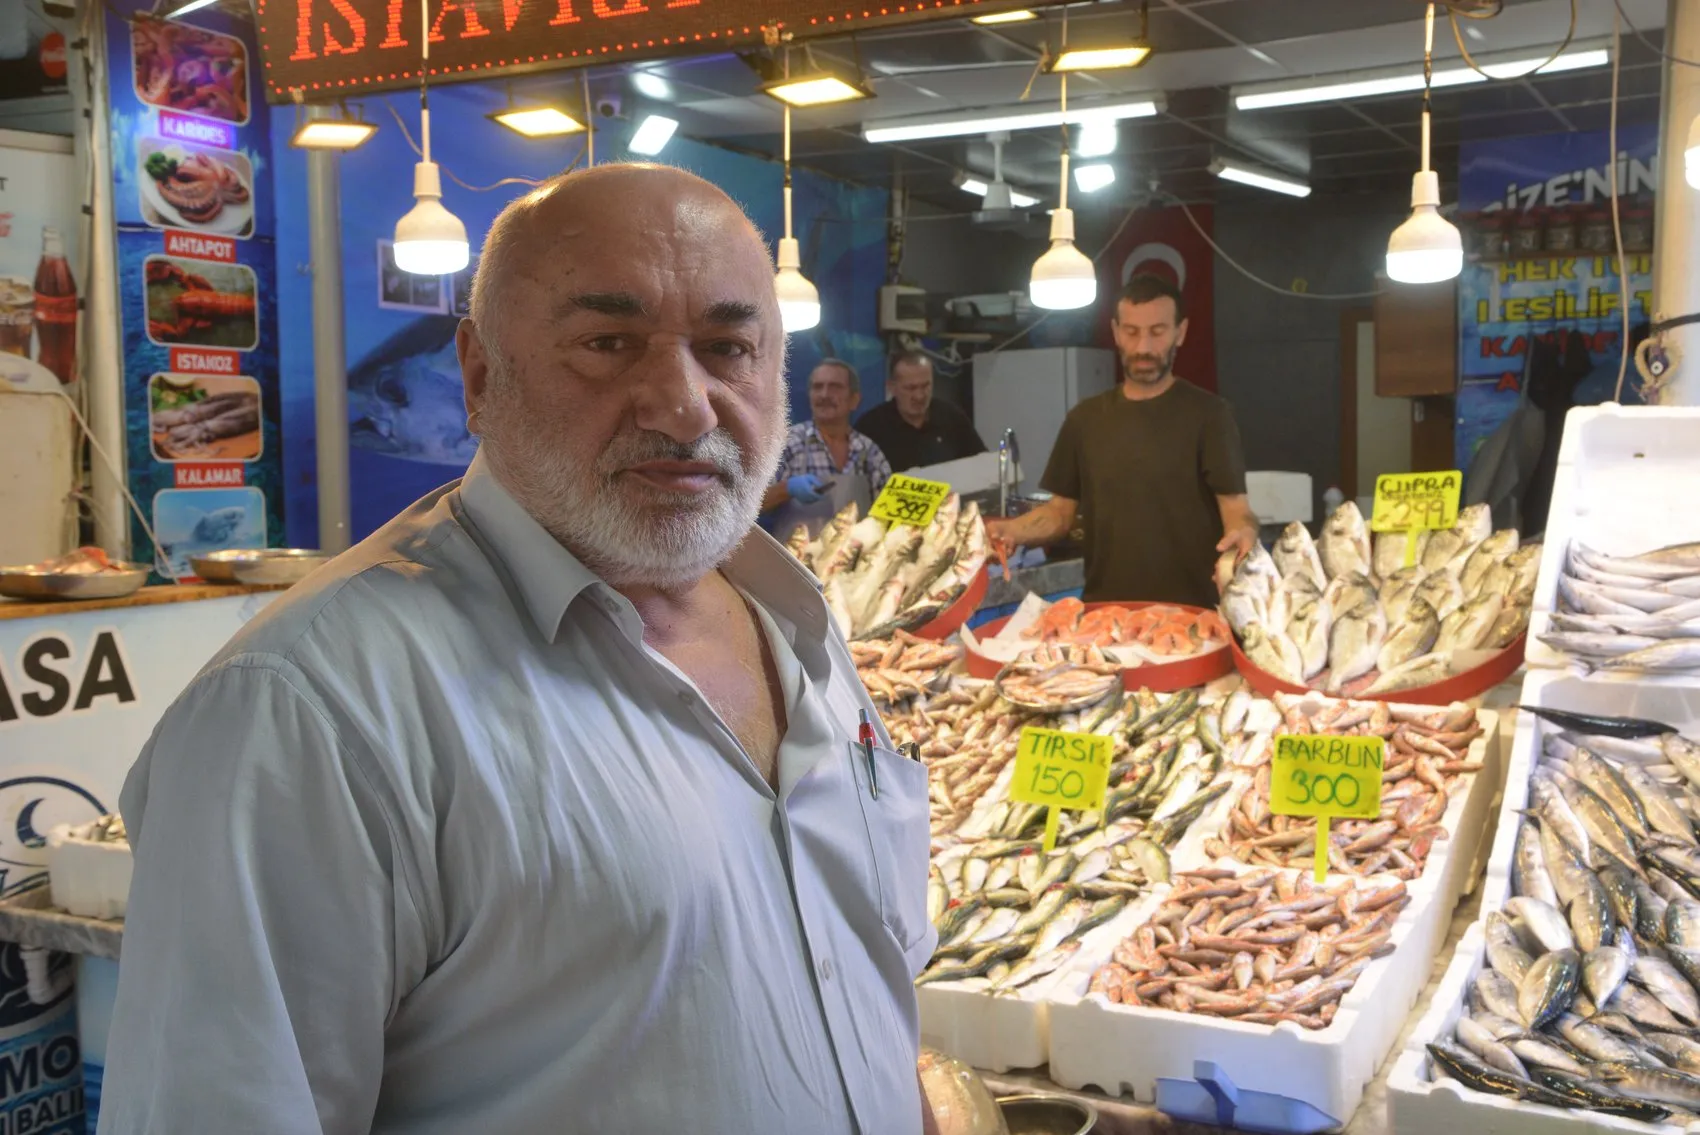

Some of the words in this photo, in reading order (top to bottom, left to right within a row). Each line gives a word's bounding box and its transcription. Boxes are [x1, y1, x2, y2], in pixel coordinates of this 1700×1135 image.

[168, 235, 232, 259] AHTAPOT
[176, 468, 242, 485] KALAMAR
[886, 498, 930, 520] 399
[1278, 738, 1382, 769] BARBUN
[1029, 762, 1085, 799] 150
[1286, 768, 1361, 808] 300
